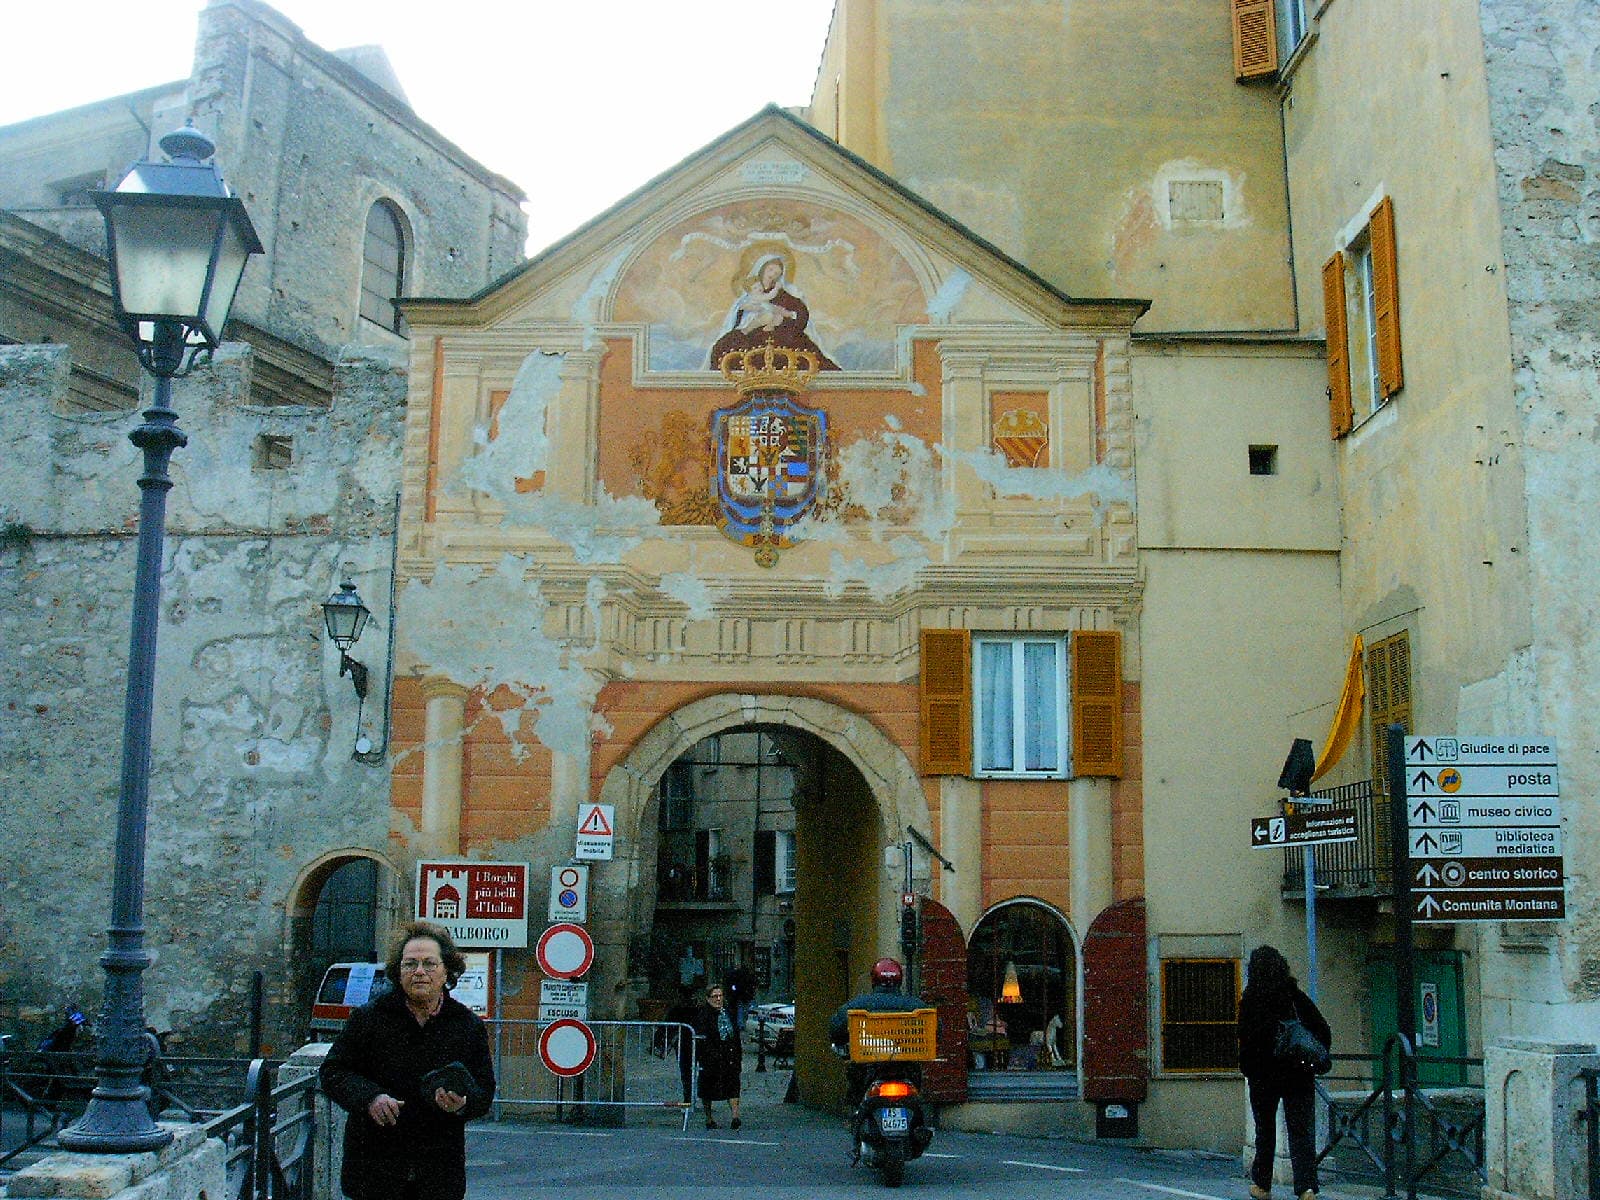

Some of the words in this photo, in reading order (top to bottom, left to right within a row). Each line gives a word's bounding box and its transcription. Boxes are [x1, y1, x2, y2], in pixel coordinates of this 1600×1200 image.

[1460, 743, 1505, 754] Giudice
[1508, 743, 1519, 754] di
[1522, 745, 1550, 756] pace
[1508, 772, 1551, 788] posta
[1468, 808, 1511, 817] museo
[1515, 806, 1553, 817] civico
[1495, 831, 1554, 842] biblioteca
[1496, 844, 1555, 854] mediatica
[476, 872, 480, 882] I
[483, 871, 517, 885] Borghi
[1468, 869, 1510, 880] centro
[1513, 868, 1558, 879] storico
[475, 887, 491, 900] più
[494, 887, 516, 898] belli
[476, 901, 513, 913] d'Italia
[1505, 899, 1558, 910] Montana
